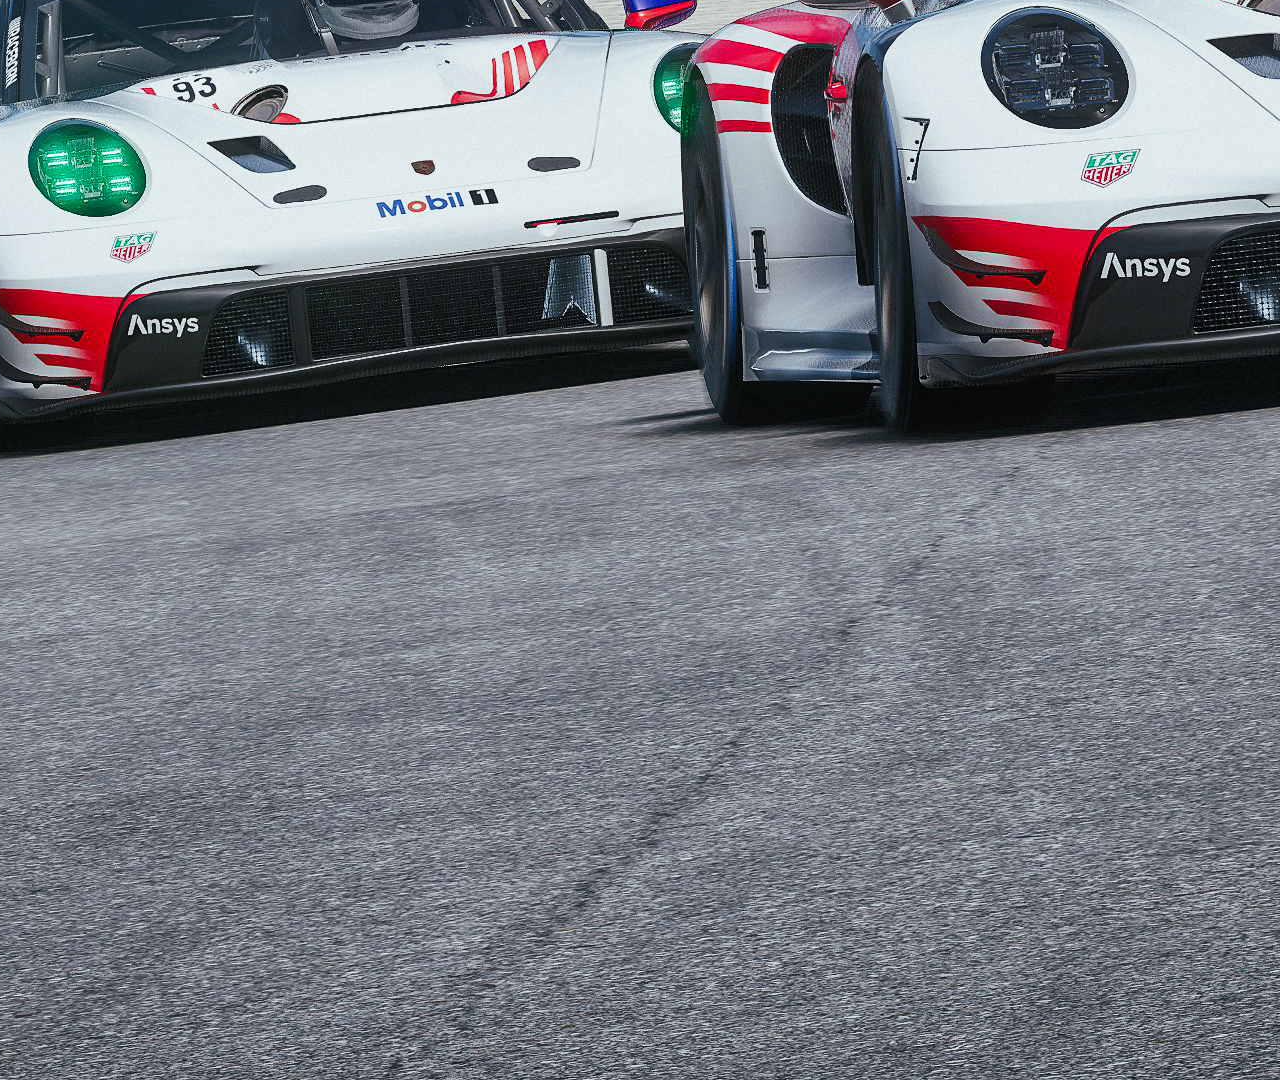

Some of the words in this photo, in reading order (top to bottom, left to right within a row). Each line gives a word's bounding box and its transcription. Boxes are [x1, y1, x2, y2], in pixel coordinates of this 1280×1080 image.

[5, 26, 20, 89] RACEBORN
[172, 76, 217, 102] 93
[1091, 151, 1135, 168] TAG
[1084, 164, 1131, 185] HEUER
[376, 191, 464, 218] Mobil
[475, 188, 493, 205] 1
[112, 244, 151, 261] HEUER
[116, 233, 153, 247] TAG
[1100, 252, 1191, 283] Ansys
[127, 313, 200, 338] Ansys
